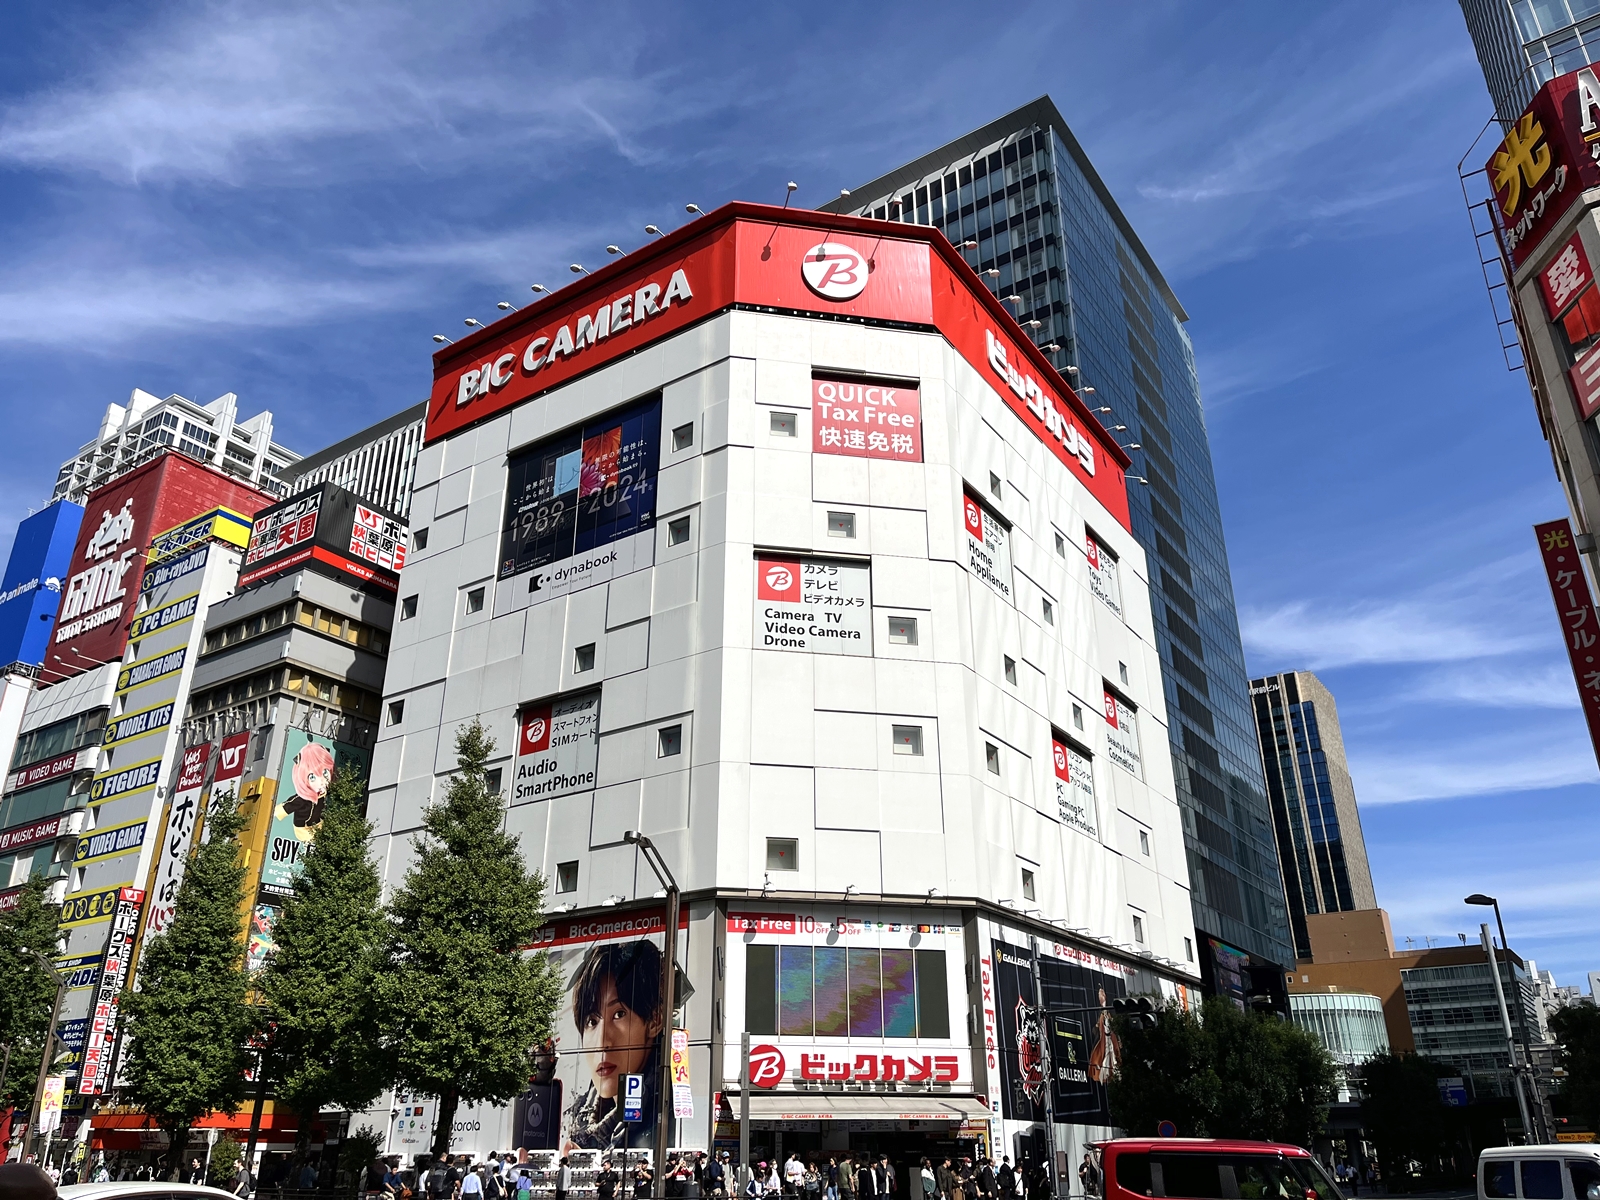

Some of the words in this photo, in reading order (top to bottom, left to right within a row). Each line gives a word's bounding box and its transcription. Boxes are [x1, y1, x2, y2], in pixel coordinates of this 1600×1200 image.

[1492, 111, 1551, 217] 光
[1505, 165, 1568, 250] ネットワーク
[457, 352, 516, 406] BIC
[523, 268, 693, 371] CAMERA
[817, 383, 897, 407] QUICK
[985, 328, 1096, 478] ビックカメラ
[817, 402, 859, 423] Tax
[864, 406, 915, 428] Free
[819, 426, 915, 454] 快速免税
[587, 468, 648, 515] 2024
[271, 493, 321, 527] ボークス
[510, 501, 565, 542] 1989
[250, 529, 278, 551] 秋葉原
[277, 511, 317, 551] 天国
[353, 524, 394, 553] 秋葉原
[246, 544, 276, 565] ホビー
[350, 541, 392, 566] ホビー
[554, 551, 618, 581] dynabook
[968, 538, 993, 568] Home
[153, 549, 207, 586] Blu-ray&DVD
[242, 572, 255, 583] VOLKS
[346, 562, 365, 577] VOLKS
[365, 572, 398, 590] AKIHABARA
[804, 564, 838, 576] カメラ
[970, 555, 1010, 596] Appliance
[7, 578, 39, 601] animate
[804, 579, 839, 591] テレビ
[804, 593, 865, 608] ビデオカメラ
[142, 615, 160, 634] PC
[161, 597, 197, 622] GAME
[764, 608, 815, 622] Camera
[824, 612, 843, 623] TV
[764, 621, 806, 635] Video
[808, 625, 861, 639] Camera
[764, 634, 806, 648] Drone
[129, 662, 161, 685] CHARACTER
[161, 650, 184, 674] GOODS
[554, 699, 594, 718] オーディオ
[116, 714, 147, 740] MODEL
[147, 705, 172, 729] KITS
[552, 713, 600, 733] スマートフォン
[551, 728, 597, 748] SIMカード
[29, 764, 50, 781] VIDEO
[52, 756, 75, 774] GAME
[102, 763, 158, 797] FIGURE
[517, 758, 558, 780] Audio
[515, 771, 594, 799] SmartPhone
[1056, 781, 1064, 795] PC
[1057, 795, 1078, 817] Gaming
[1077, 805, 1085, 818] PC
[1059, 807, 1074, 824] Apple
[11, 829, 34, 844] MUSIC
[35, 821, 58, 837] GAME
[88, 830, 117, 857] VIDEO
[117, 824, 145, 851] GAME
[271, 837, 300, 865] SPY
[127, 902, 140, 936] VOLKS
[569, 916, 661, 939] BicCamera.com
[732, 915, 757, 930] Tax
[760, 917, 792, 931] Free
[847, 928, 862, 936] OFF
[1002, 953, 1031, 969] GALLERIA
[980, 955, 991, 1003] Tax
[984, 1007, 996, 1070] Free
[95, 1033, 113, 1086] PARADISE
[800, 1053, 960, 1081] ビックカメラ
[628, 1077, 640, 1096] P
[1058, 1066, 1088, 1084] GALLERIA
[452, 1120, 481, 1132] torola
